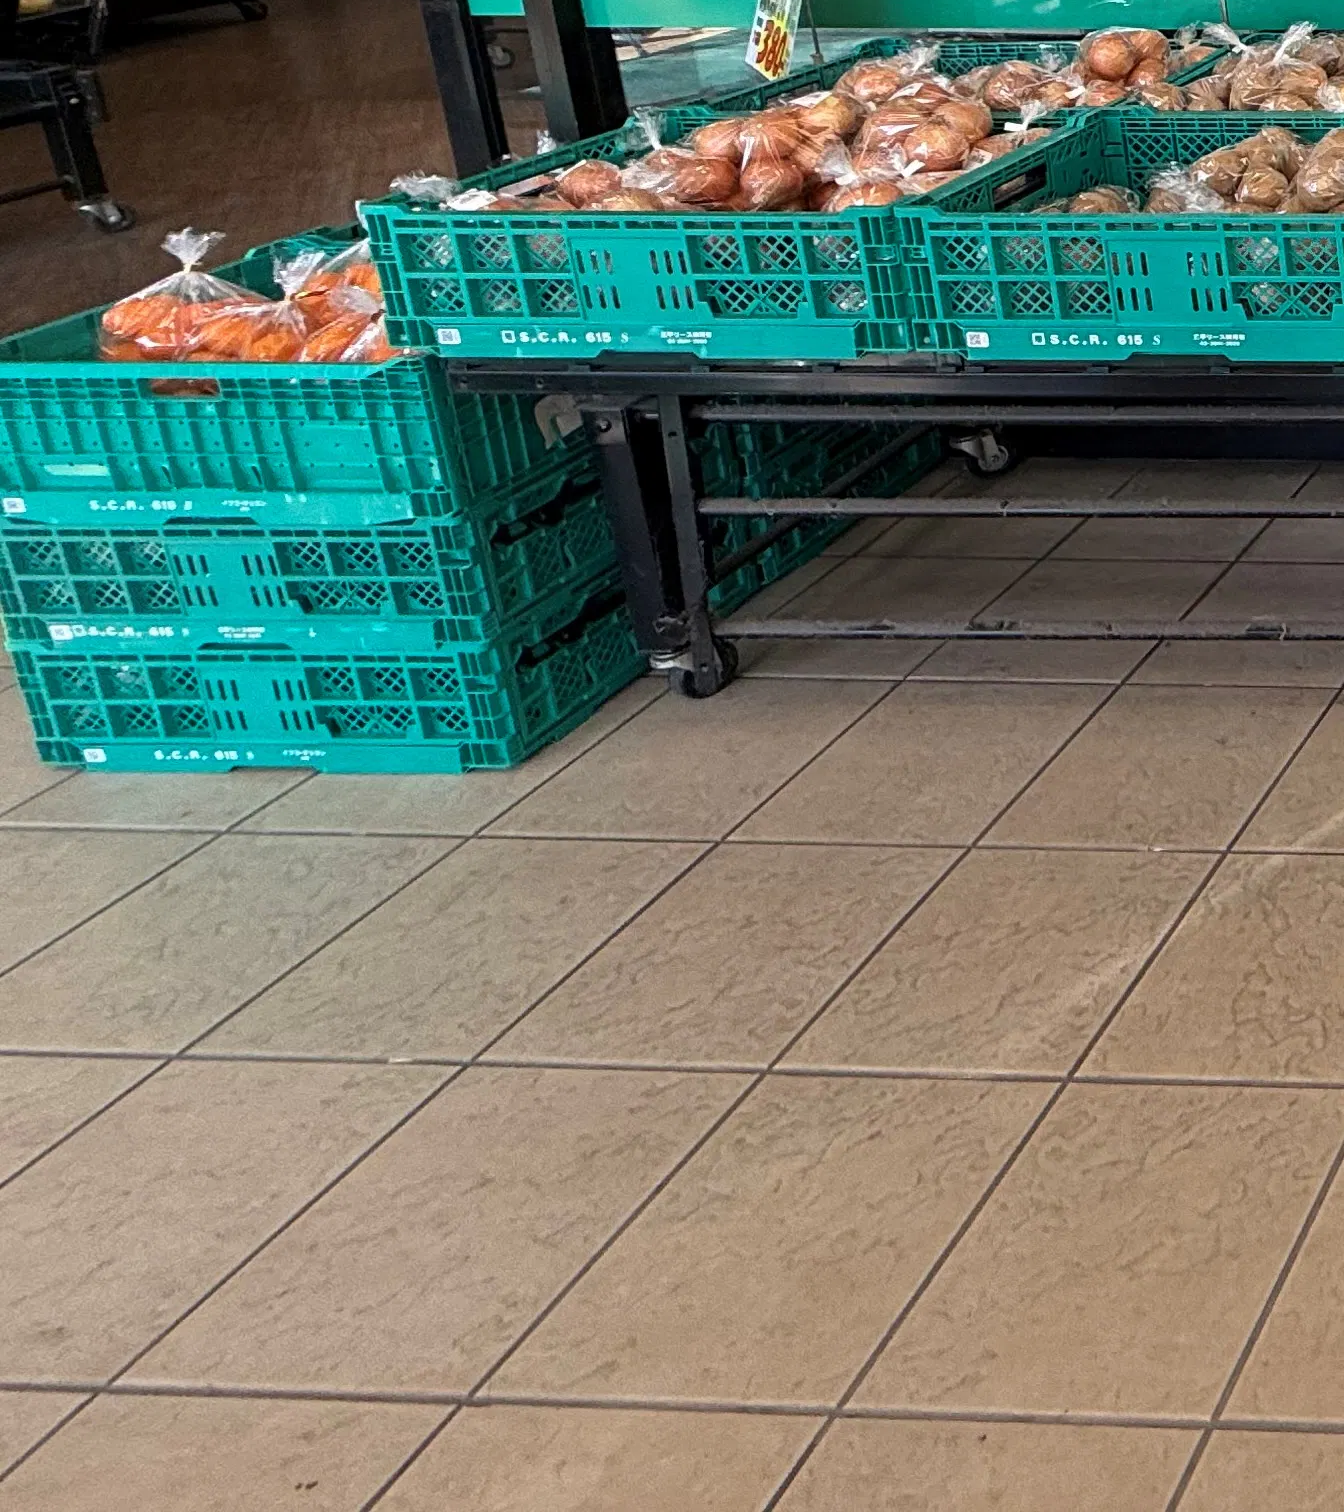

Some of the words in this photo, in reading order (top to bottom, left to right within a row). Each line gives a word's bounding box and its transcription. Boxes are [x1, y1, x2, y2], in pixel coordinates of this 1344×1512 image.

[519, 331, 577, 343] S.C.R.
[585, 332, 612, 343] 615
[1050, 334, 1108, 346] S.C.R.
[1117, 335, 1143, 345] 615
[1152, 335, 1160, 345] S
